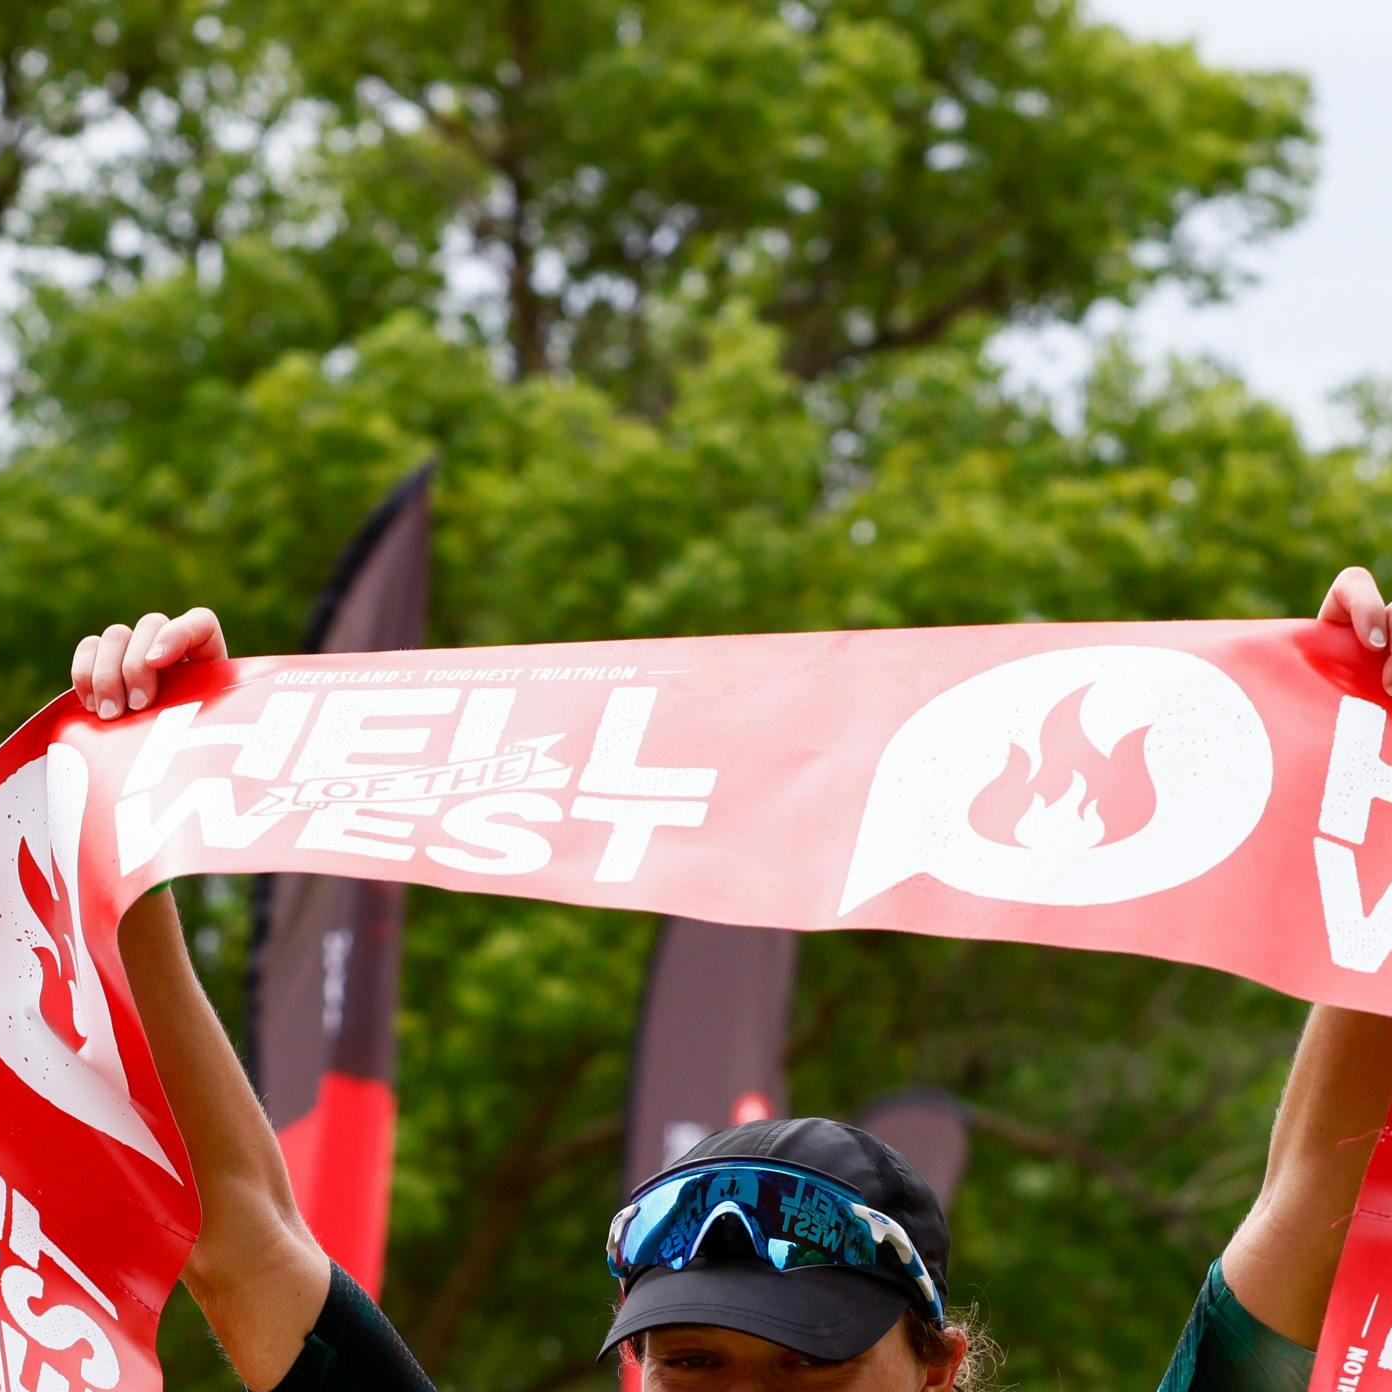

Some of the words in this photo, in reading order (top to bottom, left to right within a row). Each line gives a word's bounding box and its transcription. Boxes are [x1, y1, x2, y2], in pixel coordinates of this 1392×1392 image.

[274, 669, 414, 685] QUEENSLAND'S
[422, 668, 522, 683] TOUGHEST
[528, 666, 639, 680] TRIATHLON
[121, 686, 718, 798] HELL
[321, 777, 397, 799] OF
[414, 756, 524, 795] THE
[114, 777, 709, 883] WEST
